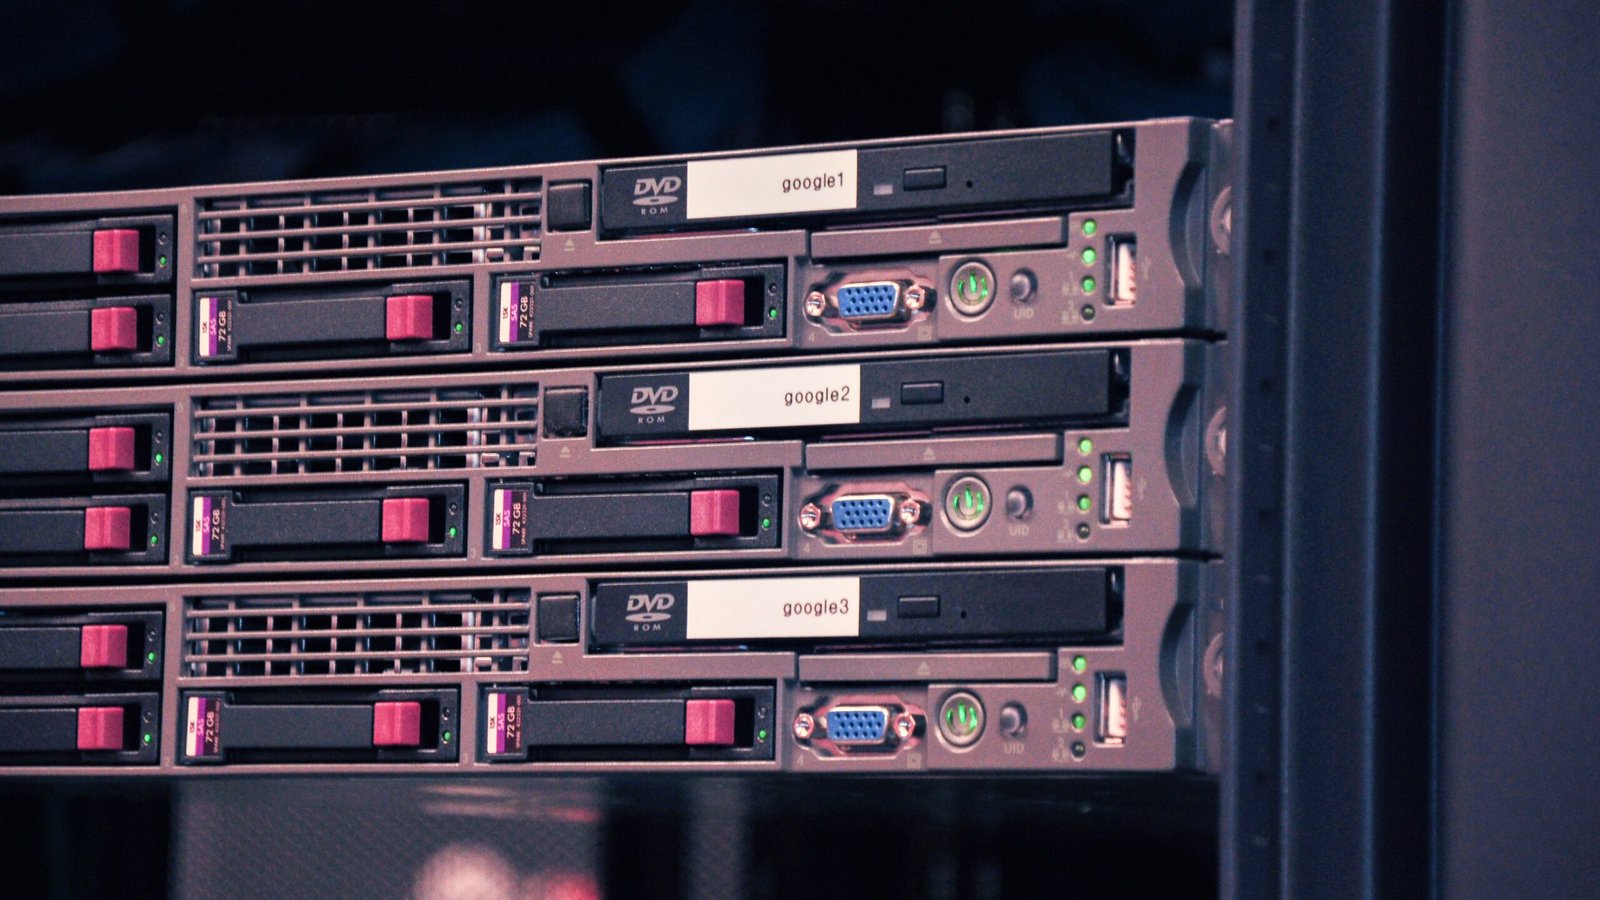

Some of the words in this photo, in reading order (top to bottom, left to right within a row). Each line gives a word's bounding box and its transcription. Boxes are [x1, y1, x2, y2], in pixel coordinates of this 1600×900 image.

[634, 176, 682, 197] DVD
[782, 172, 844, 193] google1
[640, 206, 669, 215] ROM
[520, 296, 528, 312] GB
[218, 311, 226, 327] GB
[510, 304, 518, 322] SAS
[519, 314, 528, 328] 72
[1013, 307, 1034, 320] UID
[209, 318, 217, 335] SAS
[218, 328, 226, 341] 72
[630, 385, 679, 405] DVD
[784, 385, 850, 406] google2
[637, 415, 666, 424] ROM
[212, 509, 220, 525] GB
[503, 509, 511, 527] SAS
[513, 503, 521, 519] GB
[212, 527, 220, 541] 72
[512, 520, 521, 534] 72
[1008, 524, 1030, 536] UID
[625, 593, 675, 613] DVD
[783, 598, 849, 617] google3
[633, 623, 662, 632] ROM
[206, 711, 214, 727] GB
[497, 713, 505, 731] SAS
[507, 706, 515, 722] GB
[206, 729, 214, 743] 72
[506, 724, 515, 739] 72
[1003, 742, 1025, 754] UID
